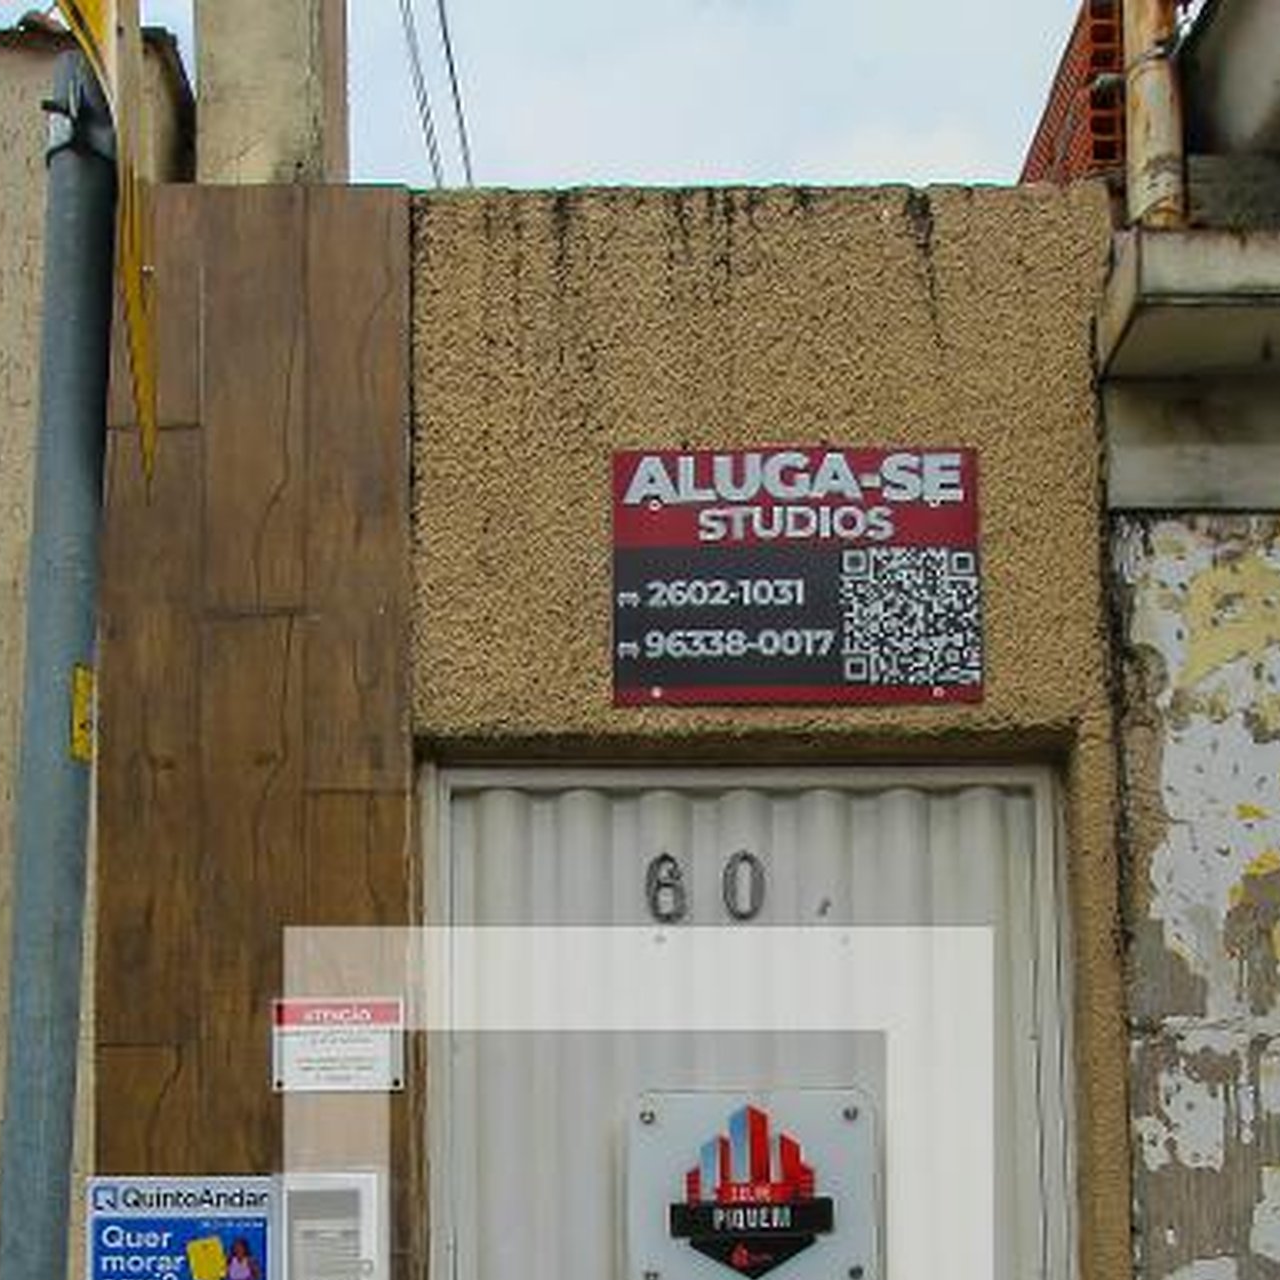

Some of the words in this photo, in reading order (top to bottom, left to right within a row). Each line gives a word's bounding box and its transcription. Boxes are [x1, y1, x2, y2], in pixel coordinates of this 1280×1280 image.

[624, 452, 963, 504] ALUGA-SE
[699, 506, 894, 541] STUDIOS
[646, 578, 804, 606] 2602-1031
[645, 628, 833, 658] 96338-0017
[646, 850, 765, 924] 60
[122, 1186, 269, 1208] QuintoAndar
[102, 1226, 172, 1248] Quer
[101, 1255, 185, 1272] morar
